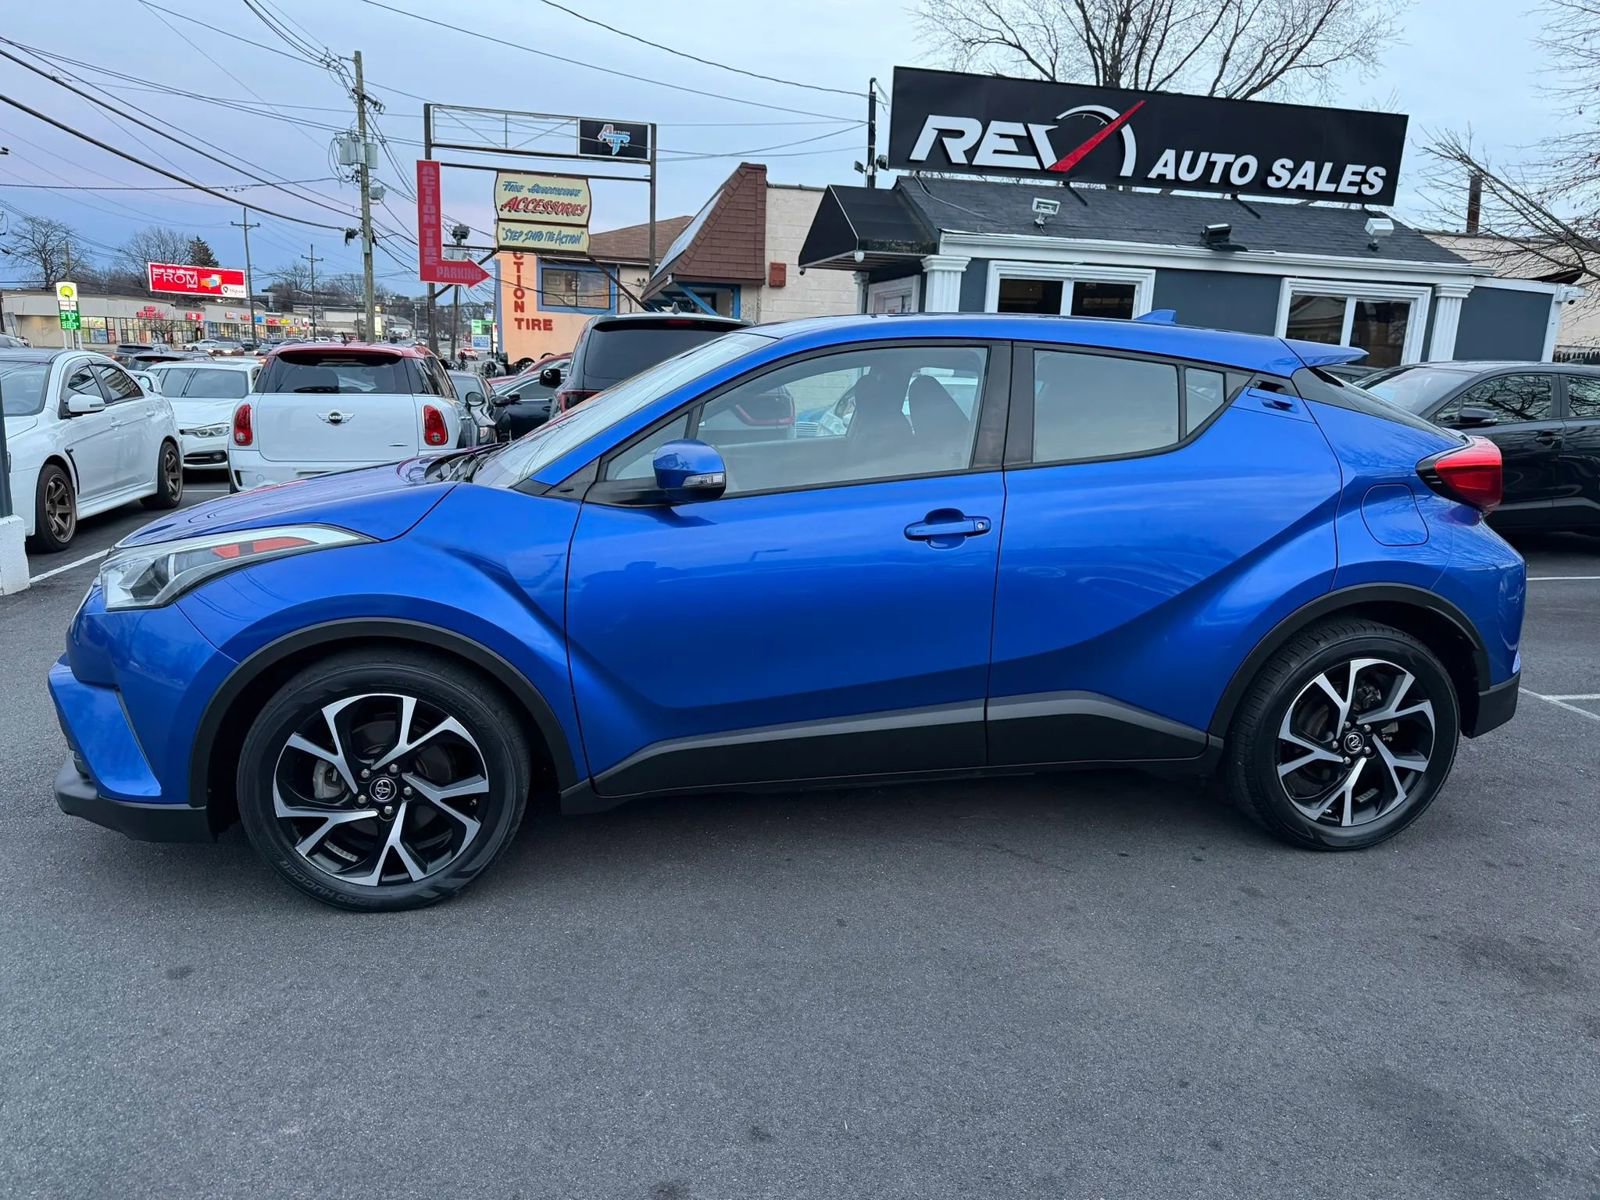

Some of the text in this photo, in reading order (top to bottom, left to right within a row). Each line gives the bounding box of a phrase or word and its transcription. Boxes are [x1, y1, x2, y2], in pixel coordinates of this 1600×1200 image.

[1148, 149, 1387, 196] AUTO SALES
[500, 196, 588, 217] ACCESSORIES
[153, 271, 198, 285] FROM
[436, 266, 482, 281] PARKING
[514, 317, 553, 331] TIRE
